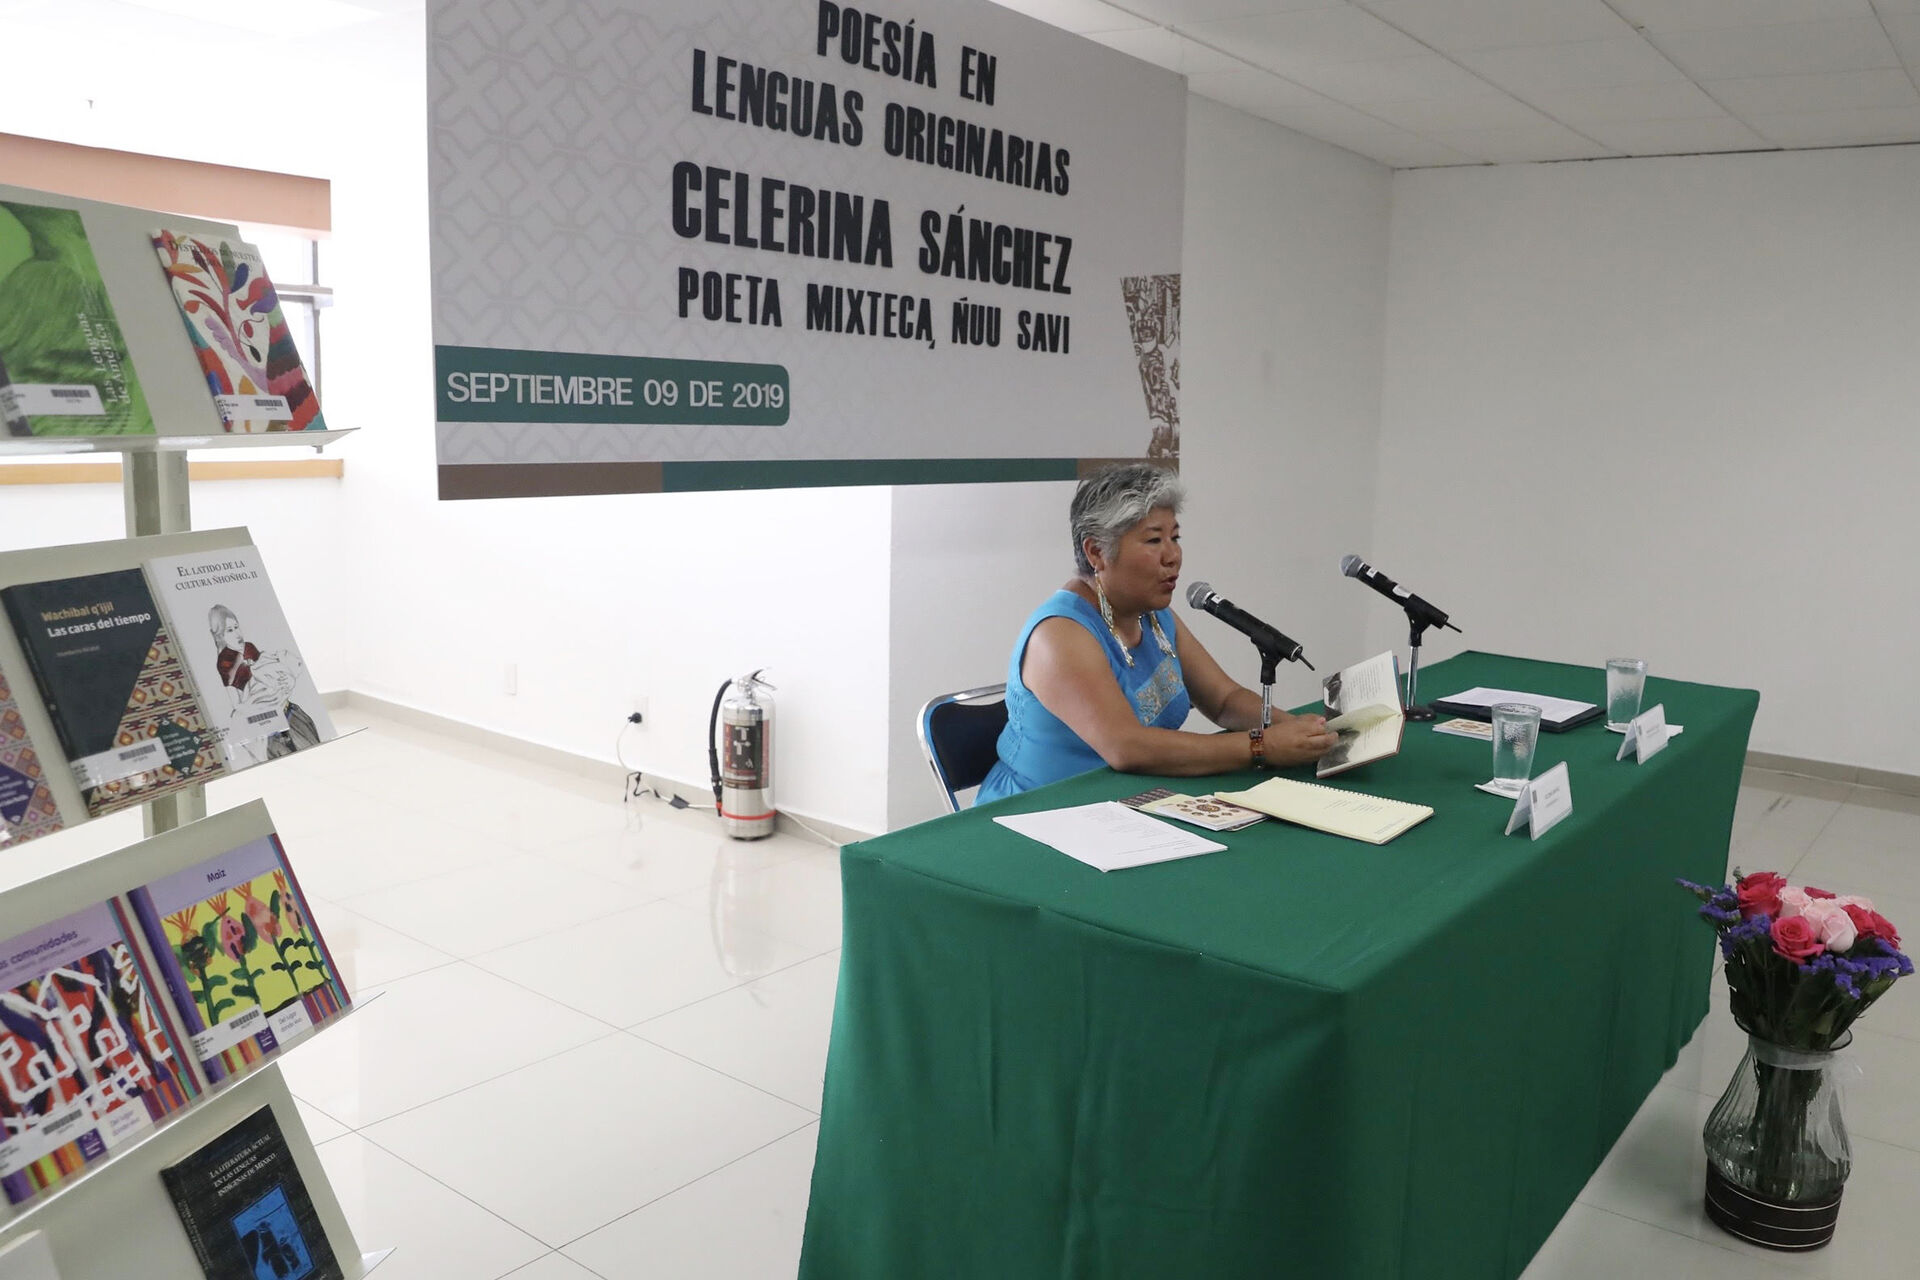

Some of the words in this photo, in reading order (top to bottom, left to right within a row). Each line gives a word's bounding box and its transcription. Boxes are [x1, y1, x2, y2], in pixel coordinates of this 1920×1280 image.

[817, 0, 937, 89] POESÍA
[960, 45, 997, 106] EN
[692, 48, 864, 148] LENGUAS
[884, 102, 1071, 197] ORIGINARIAS
[672, 161, 893, 268] CELERINA
[918, 204, 1073, 295] SÁNCHEZ
[678, 266, 782, 328] POETA
[806, 283, 935, 349] MIXTECA,
[1017, 310, 1070, 355] SAVI
[447, 371, 634, 407] SEPTIEMBRE
[643, 379, 679, 407] 09
[689, 380, 724, 408] DE
[732, 382, 785, 410] 2019
[175, 578, 213, 591] CULTURA
[191, 563, 221, 576] LATIDO
[222, 561, 234, 571] DE
[234, 560, 246, 570] LA
[41, 605, 90, 622] Wachibal
[47, 627, 67, 638] Las
[68, 622, 97, 635] caras
[97, 617, 114, 630] del
[114, 612, 151, 626] tiempo
[10, 930, 78, 965] comunidades
